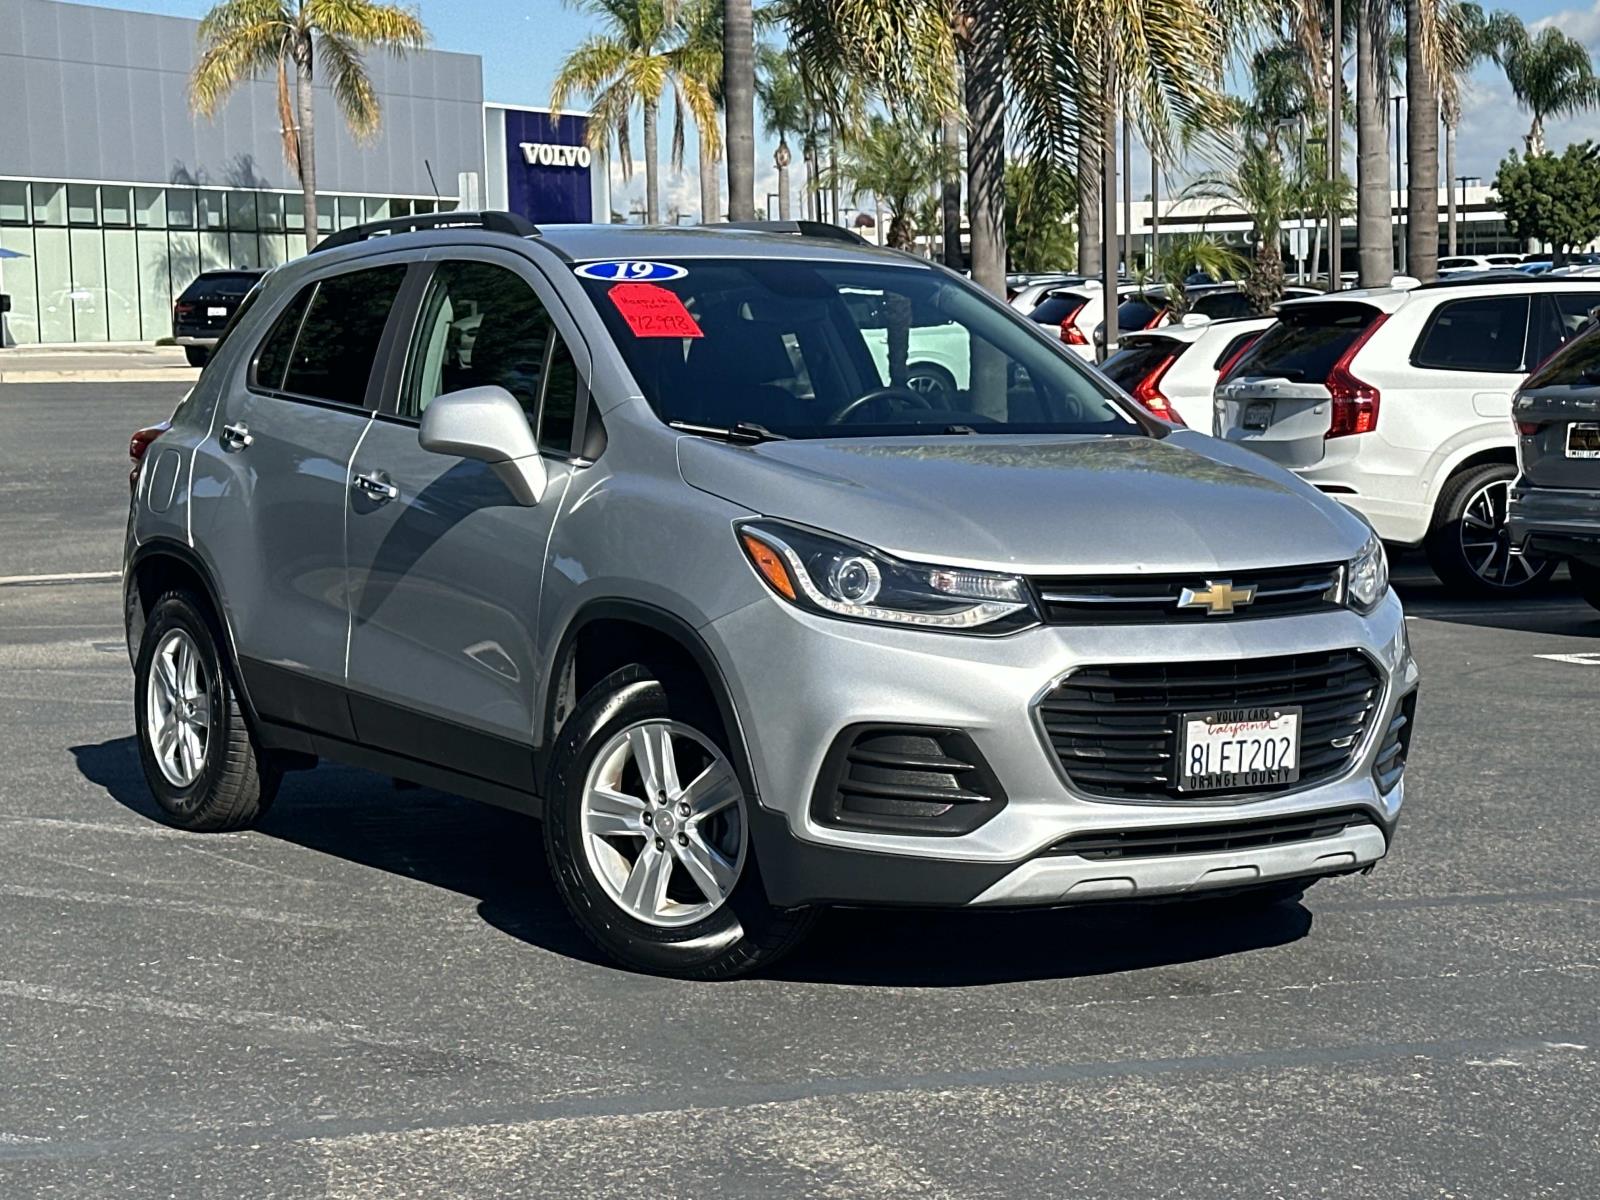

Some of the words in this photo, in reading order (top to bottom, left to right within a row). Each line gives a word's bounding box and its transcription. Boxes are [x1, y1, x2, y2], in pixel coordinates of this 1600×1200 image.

[519, 142, 591, 168] VOLVO
[609, 261, 654, 279] 19
[1216, 710, 1244, 721] VOLVO
[1248, 708, 1270, 720] CARS
[1190, 772, 1237, 790] ORANGE
[1244, 766, 1290, 786] COUNTY
